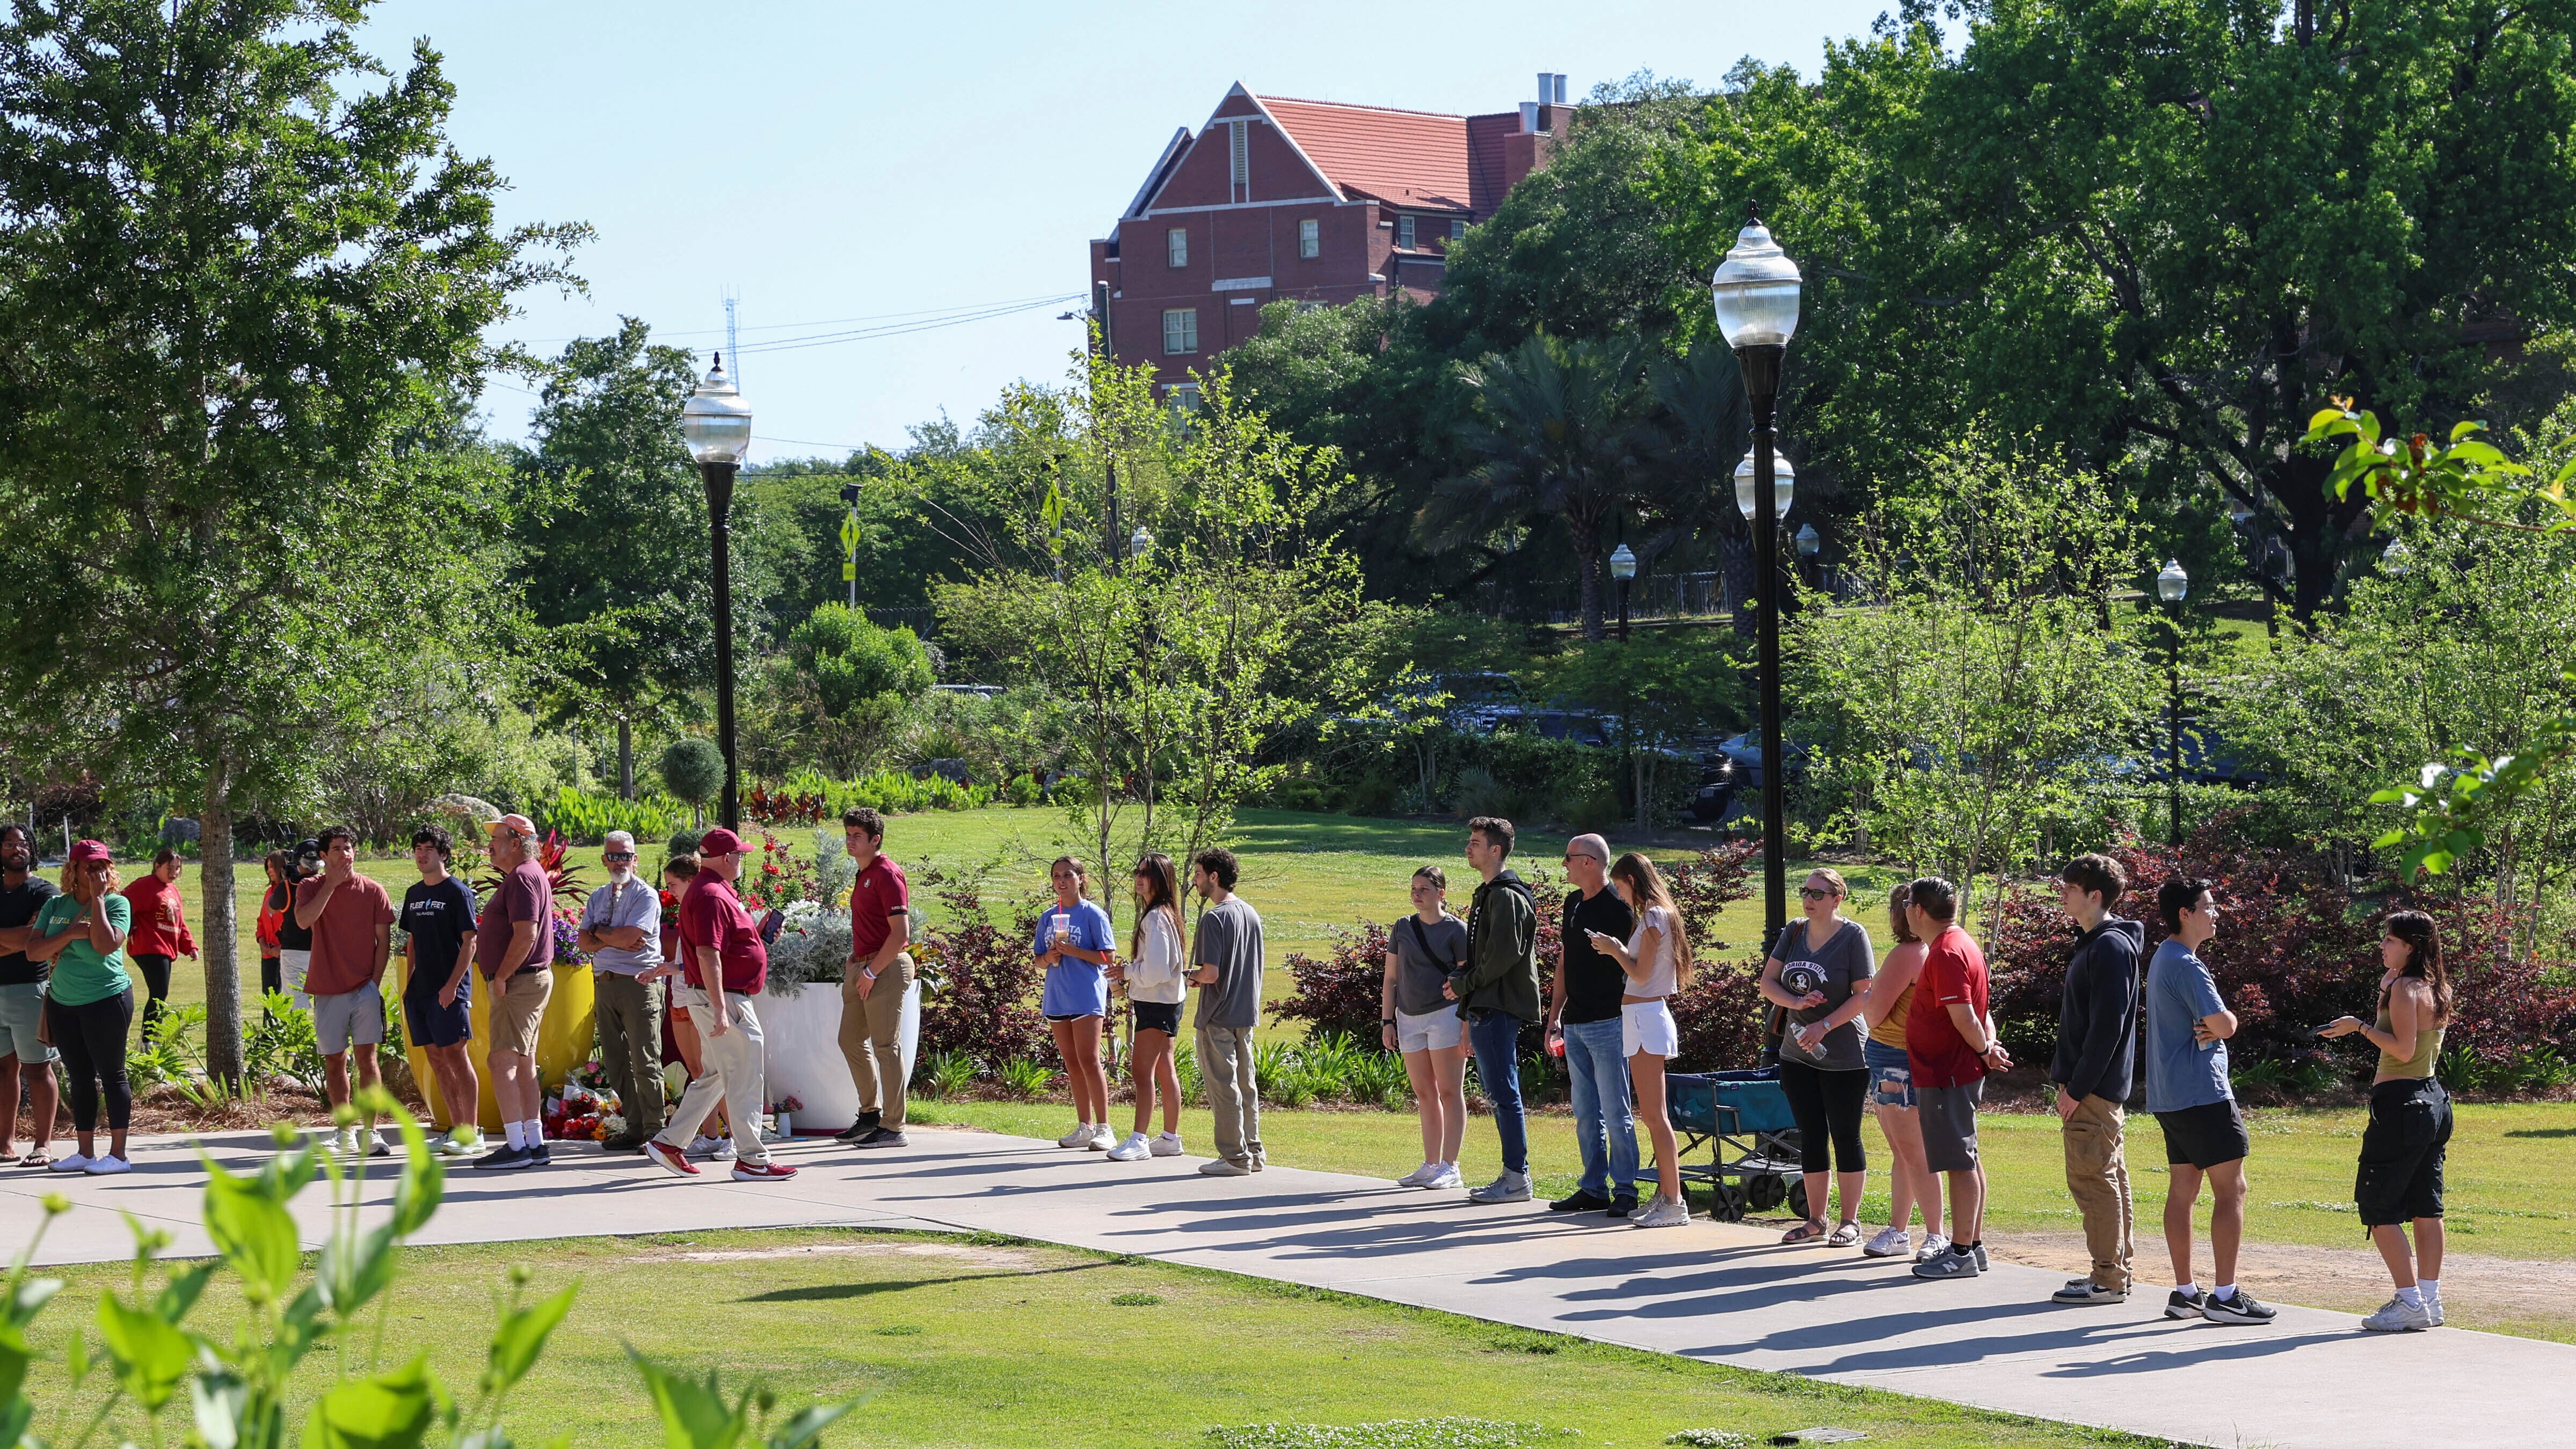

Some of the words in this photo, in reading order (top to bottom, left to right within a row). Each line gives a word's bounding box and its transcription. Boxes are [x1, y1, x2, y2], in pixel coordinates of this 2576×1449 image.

[410, 901, 425, 910] FLEET
[431, 901, 446, 909] FEET
[1809, 963, 1824, 975] STATE
